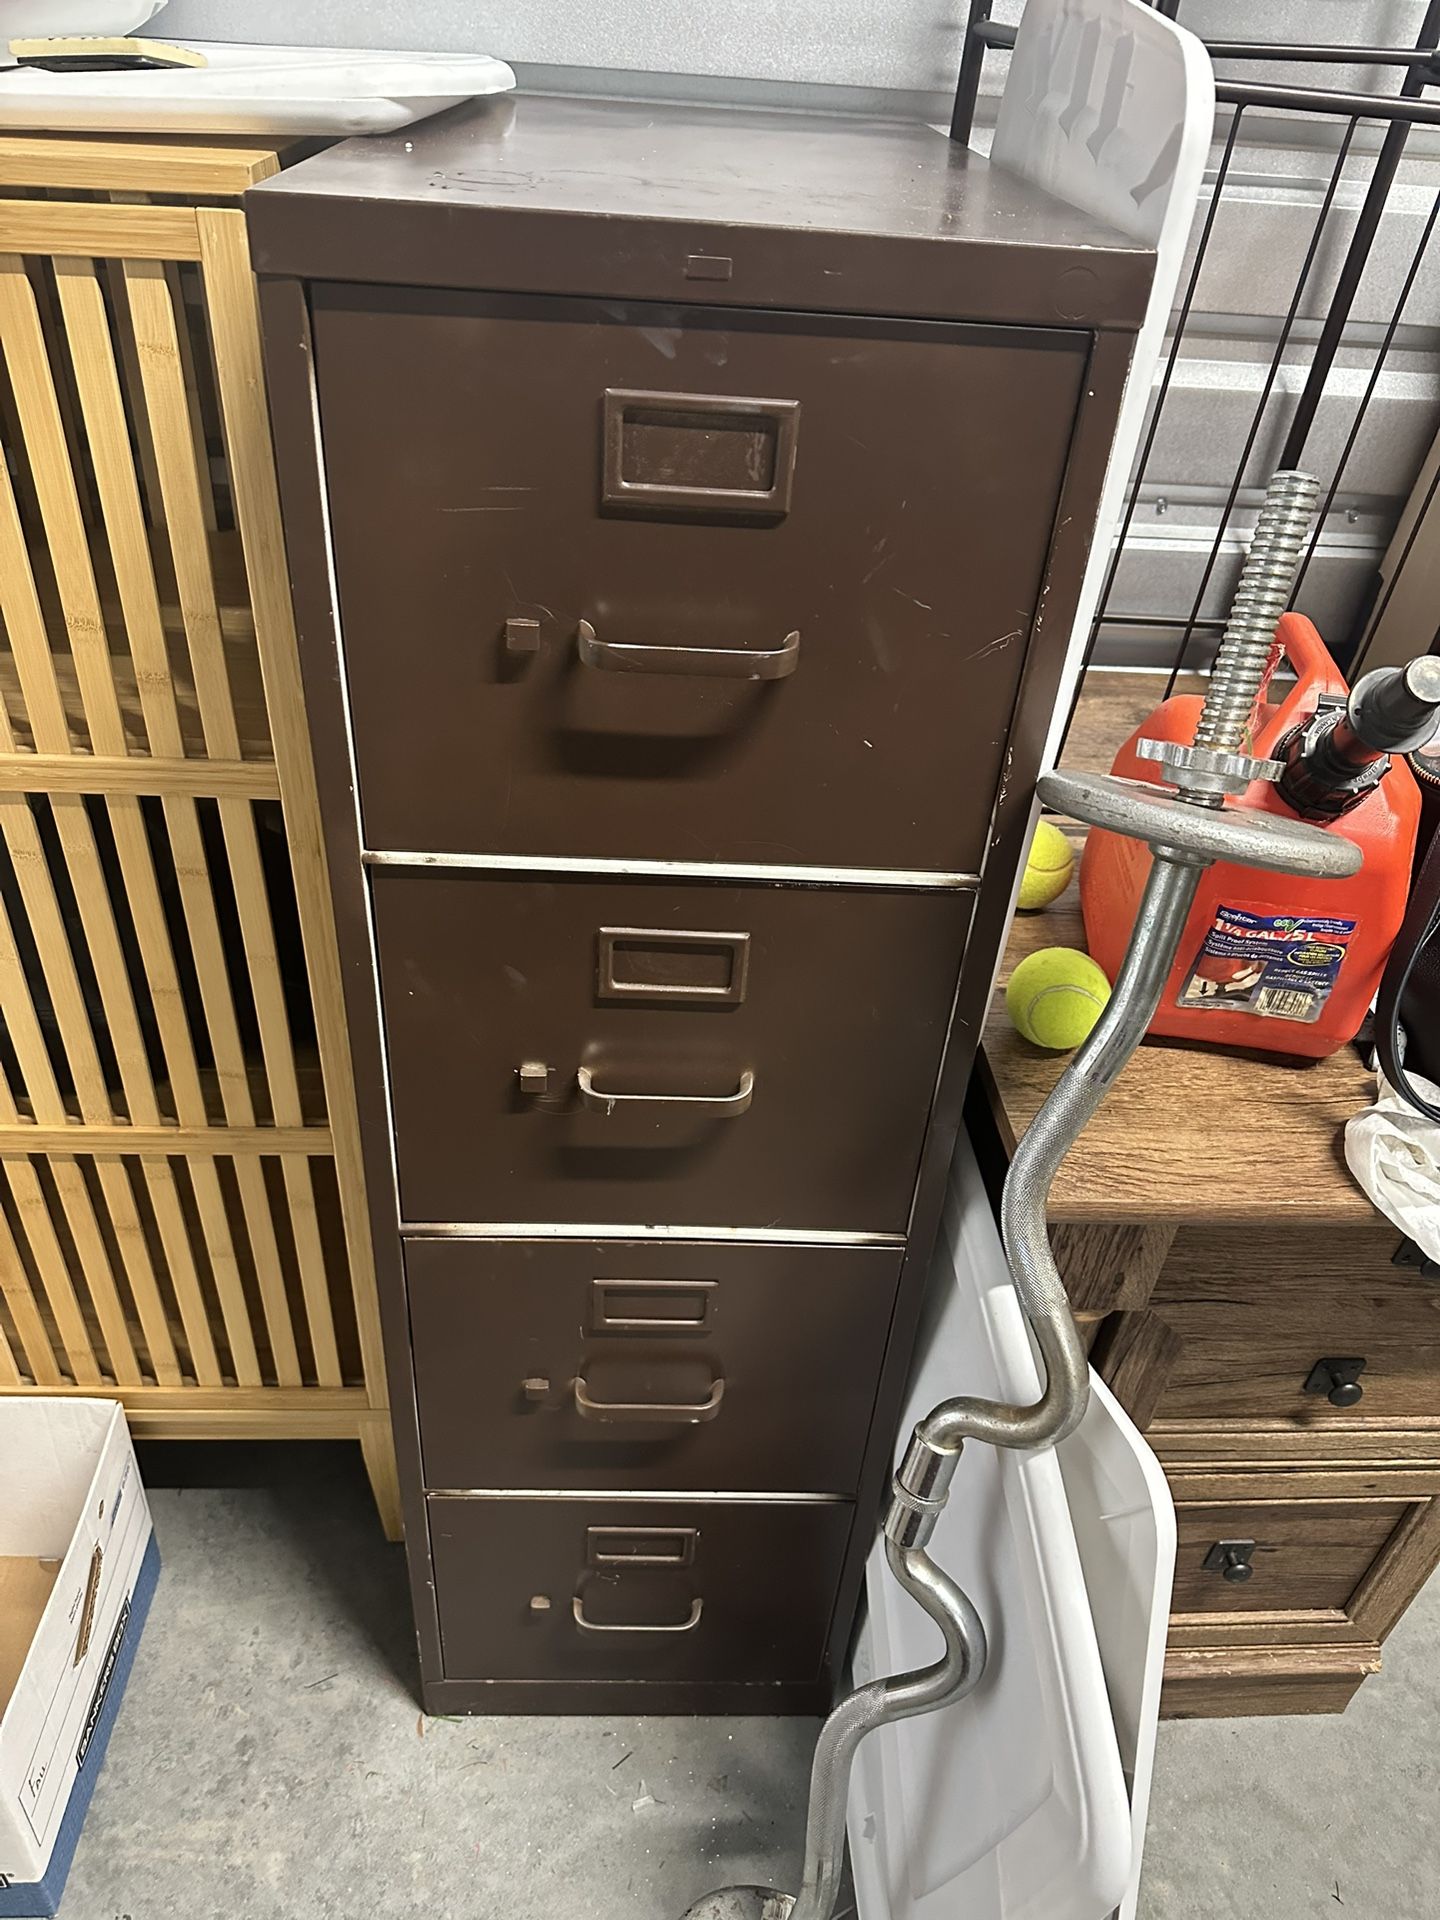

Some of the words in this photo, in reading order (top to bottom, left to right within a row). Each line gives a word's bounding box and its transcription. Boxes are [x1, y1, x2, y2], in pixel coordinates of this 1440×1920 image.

[1211, 931, 1226, 941] Spill
[1227, 935, 1245, 945] Proof
[81, 1655, 115, 1757] BANKERS
[112, 1612, 129, 1655] BOX
